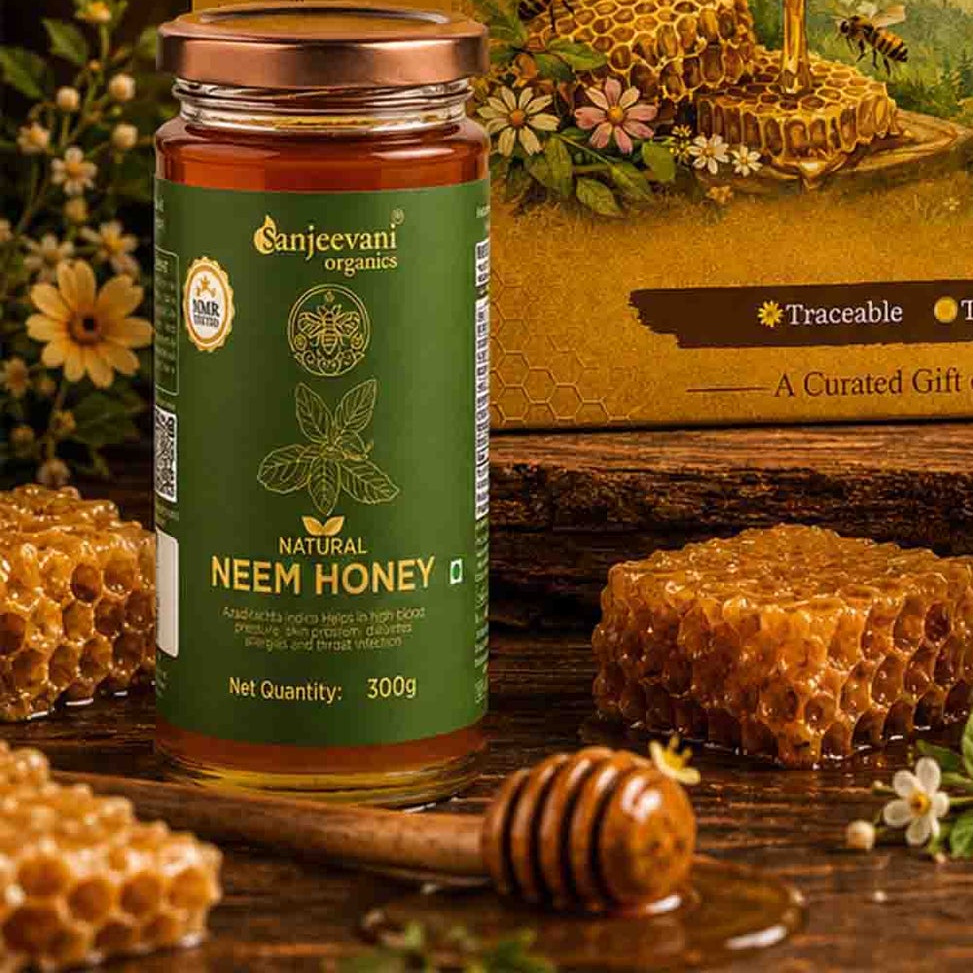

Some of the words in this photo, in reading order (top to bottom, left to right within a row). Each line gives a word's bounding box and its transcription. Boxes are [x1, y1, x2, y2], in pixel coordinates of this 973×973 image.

[254, 217, 398, 260] Sanjeevani
[324, 253, 398, 277] organics
[785, 302, 903, 326] Traceable
[774, 372, 795, 398] A
[803, 369, 902, 397] Curated
[912, 366, 961, 393] Gift
[279, 536, 367, 555] NATURAL
[211, 555, 300, 595] NEEM
[315, 555, 435, 595] HONEY
[229, 677, 256, 697] Net
[260, 680, 343, 705] Quantity:
[366, 675, 417, 699] 300g
